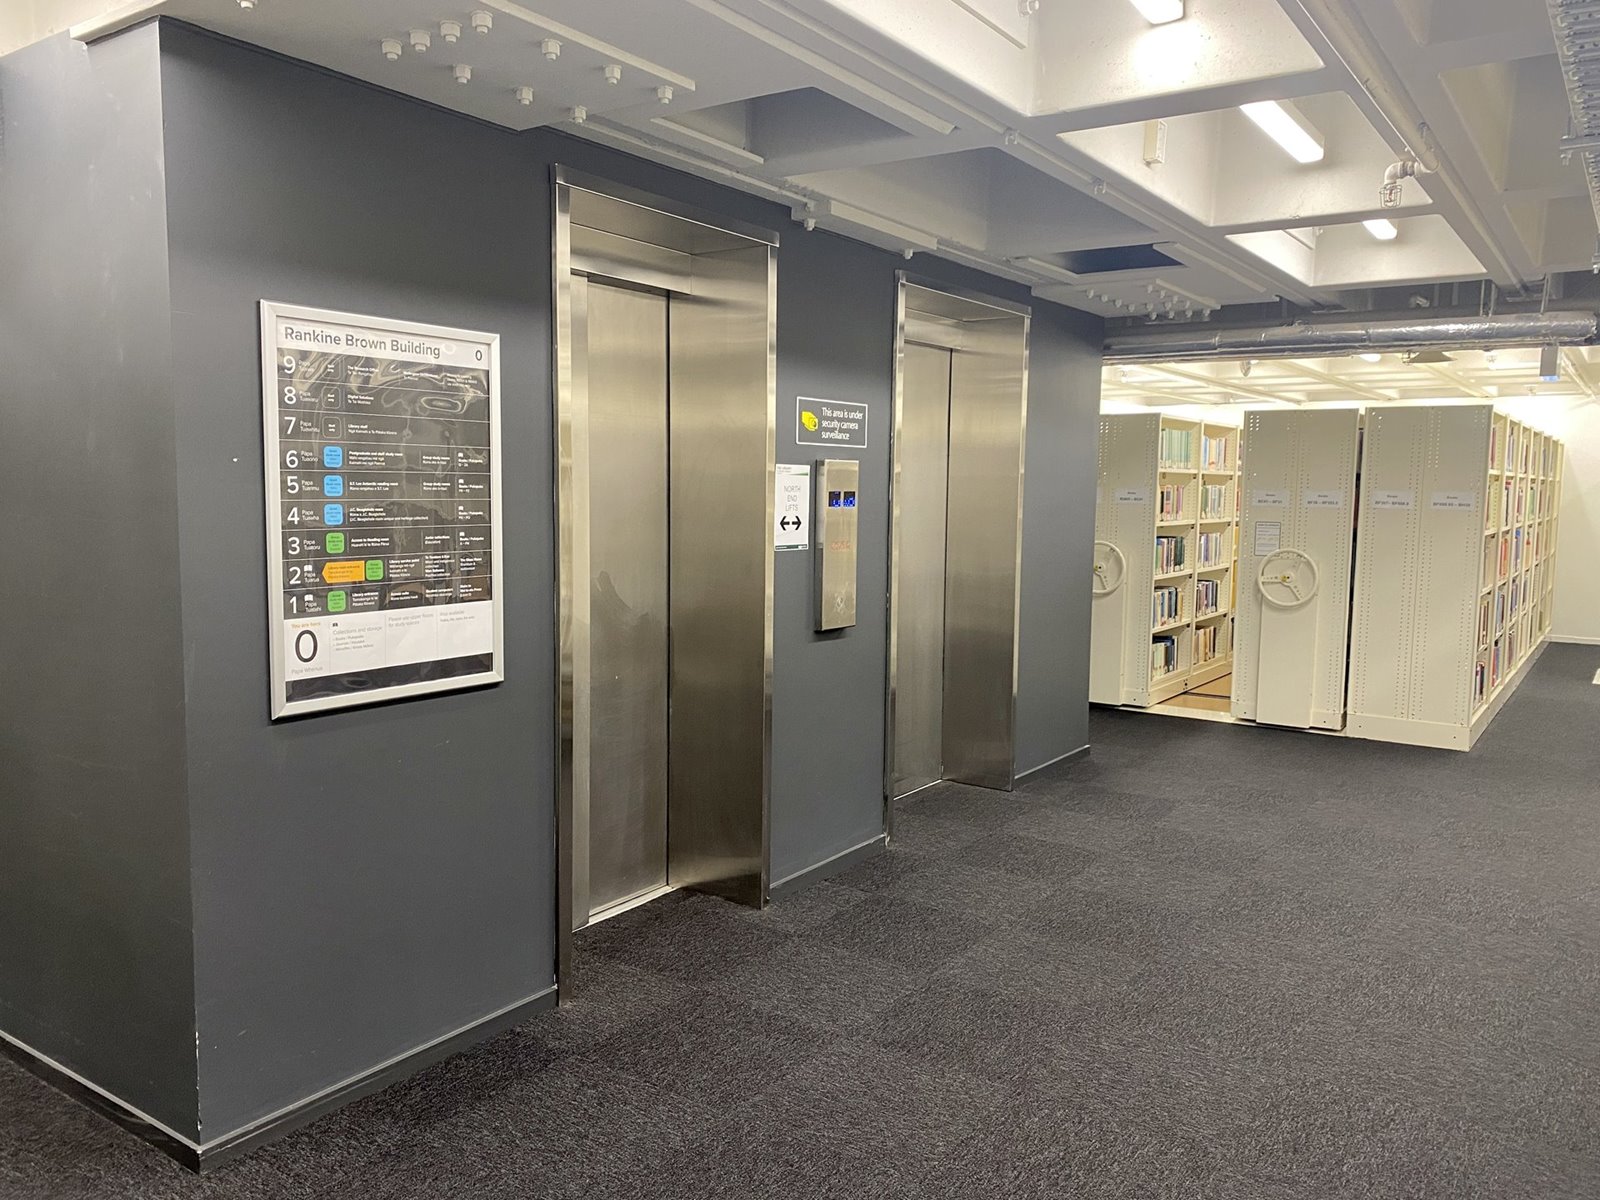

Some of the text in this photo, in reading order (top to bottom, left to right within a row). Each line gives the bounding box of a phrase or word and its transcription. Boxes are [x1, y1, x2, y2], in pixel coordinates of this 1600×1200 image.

[284, 326, 441, 359] Rankine Brown Building
[475, 349, 483, 361] 0
[283, 355, 296, 374] 9
[284, 386, 296, 404] 8
[821, 407, 864, 420] This area is under
[284, 416, 297, 435] 7
[821, 420, 859, 431] security camera
[821, 431, 850, 440] surveillance
[286, 450, 299, 468] 6
[287, 475, 299, 494] 5
[783, 485, 801, 493] NORTH
[787, 494, 798, 503] END
[287, 507, 300, 525] 4
[785, 504, 799, 512] LIFTS
[287, 536, 300, 555] 3
[289, 566, 301, 585] 2
[289, 596, 297, 614] 1
[295, 629, 318, 663] 0
